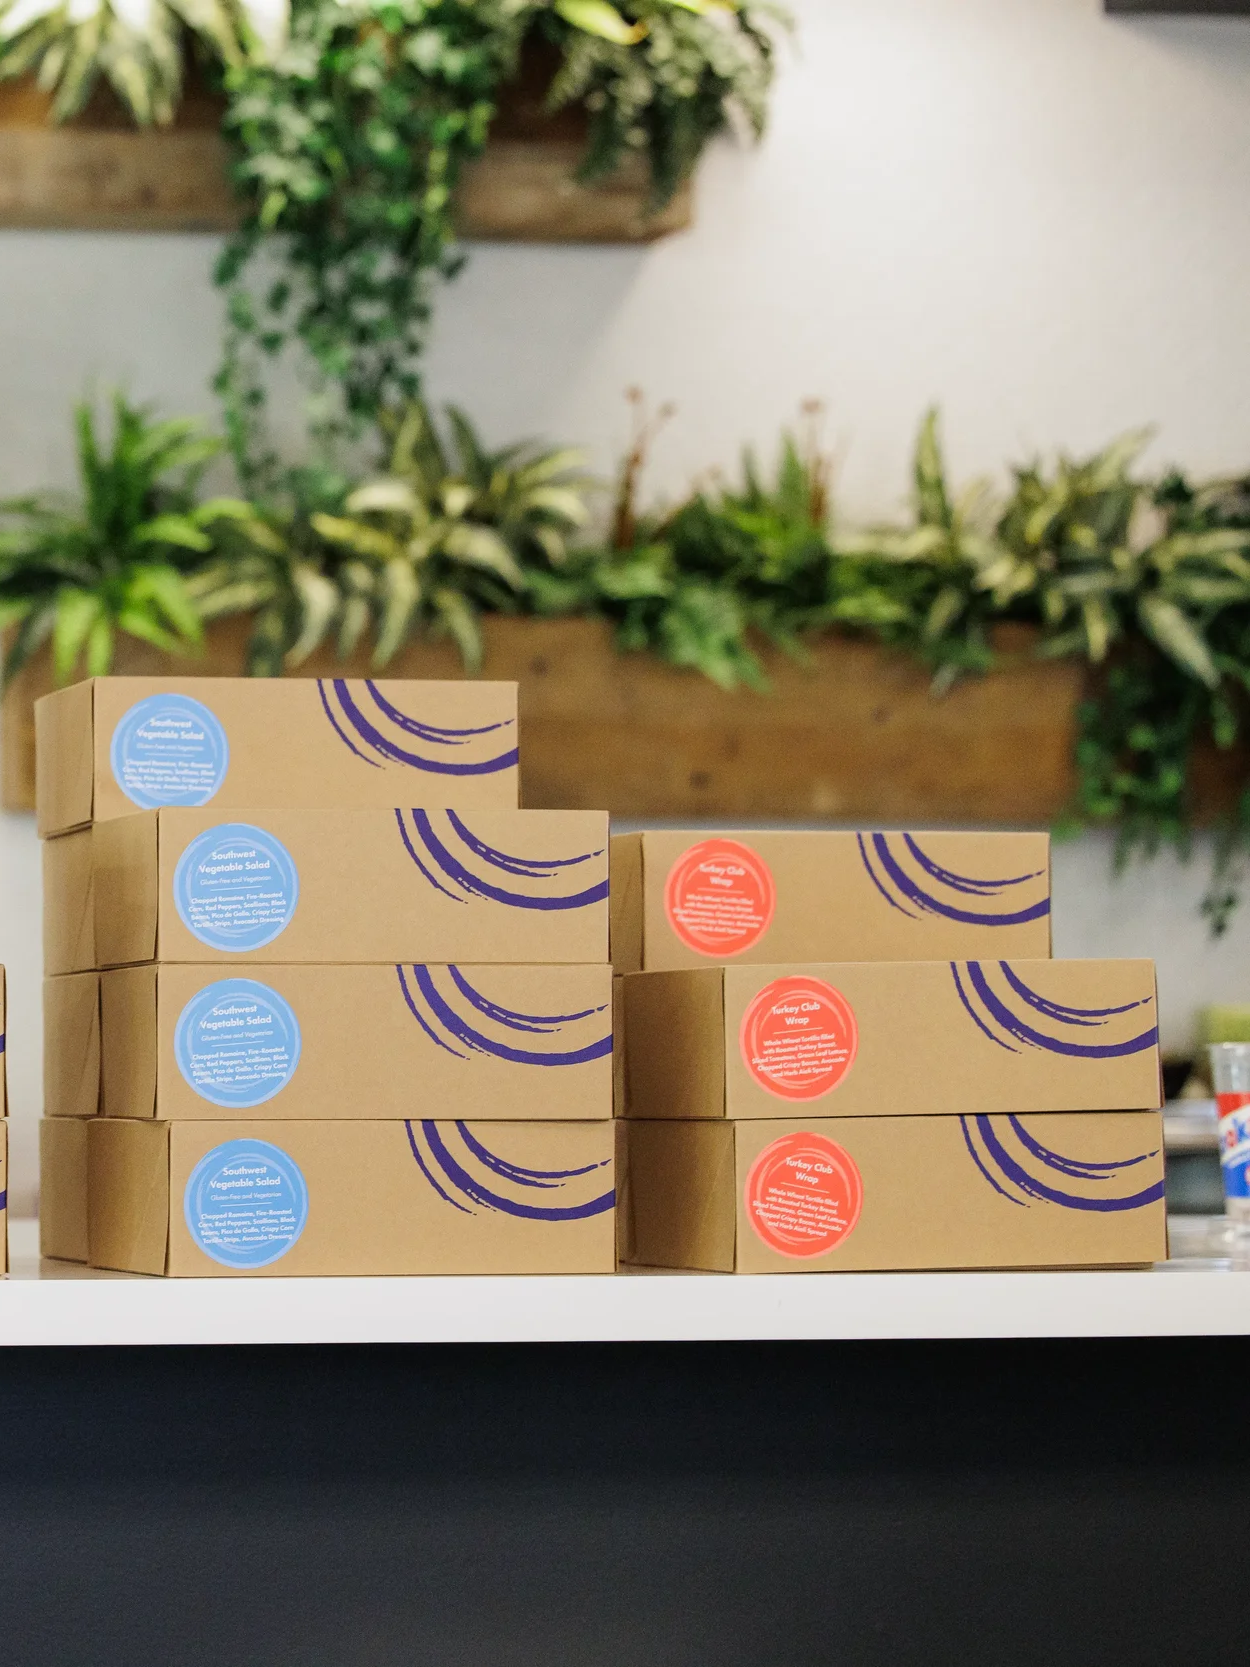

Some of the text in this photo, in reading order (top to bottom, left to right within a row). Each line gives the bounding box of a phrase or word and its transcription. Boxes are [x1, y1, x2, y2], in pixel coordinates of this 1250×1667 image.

[212, 850, 256, 860] Southwest
[199, 860, 270, 874] Vegetable Salad
[213, 1005, 257, 1016] Southwest
[772, 1002, 820, 1015] Turkey Club
[200, 1015, 272, 1030] Vegetable Salad
[785, 1017, 809, 1025] Wrap
[223, 1166, 267, 1176] Southwest
[786, 1157, 833, 1174] Turkey Club
[210, 1176, 280, 1190] Vegetable Salad
[795, 1172, 818, 1185] Wrap
